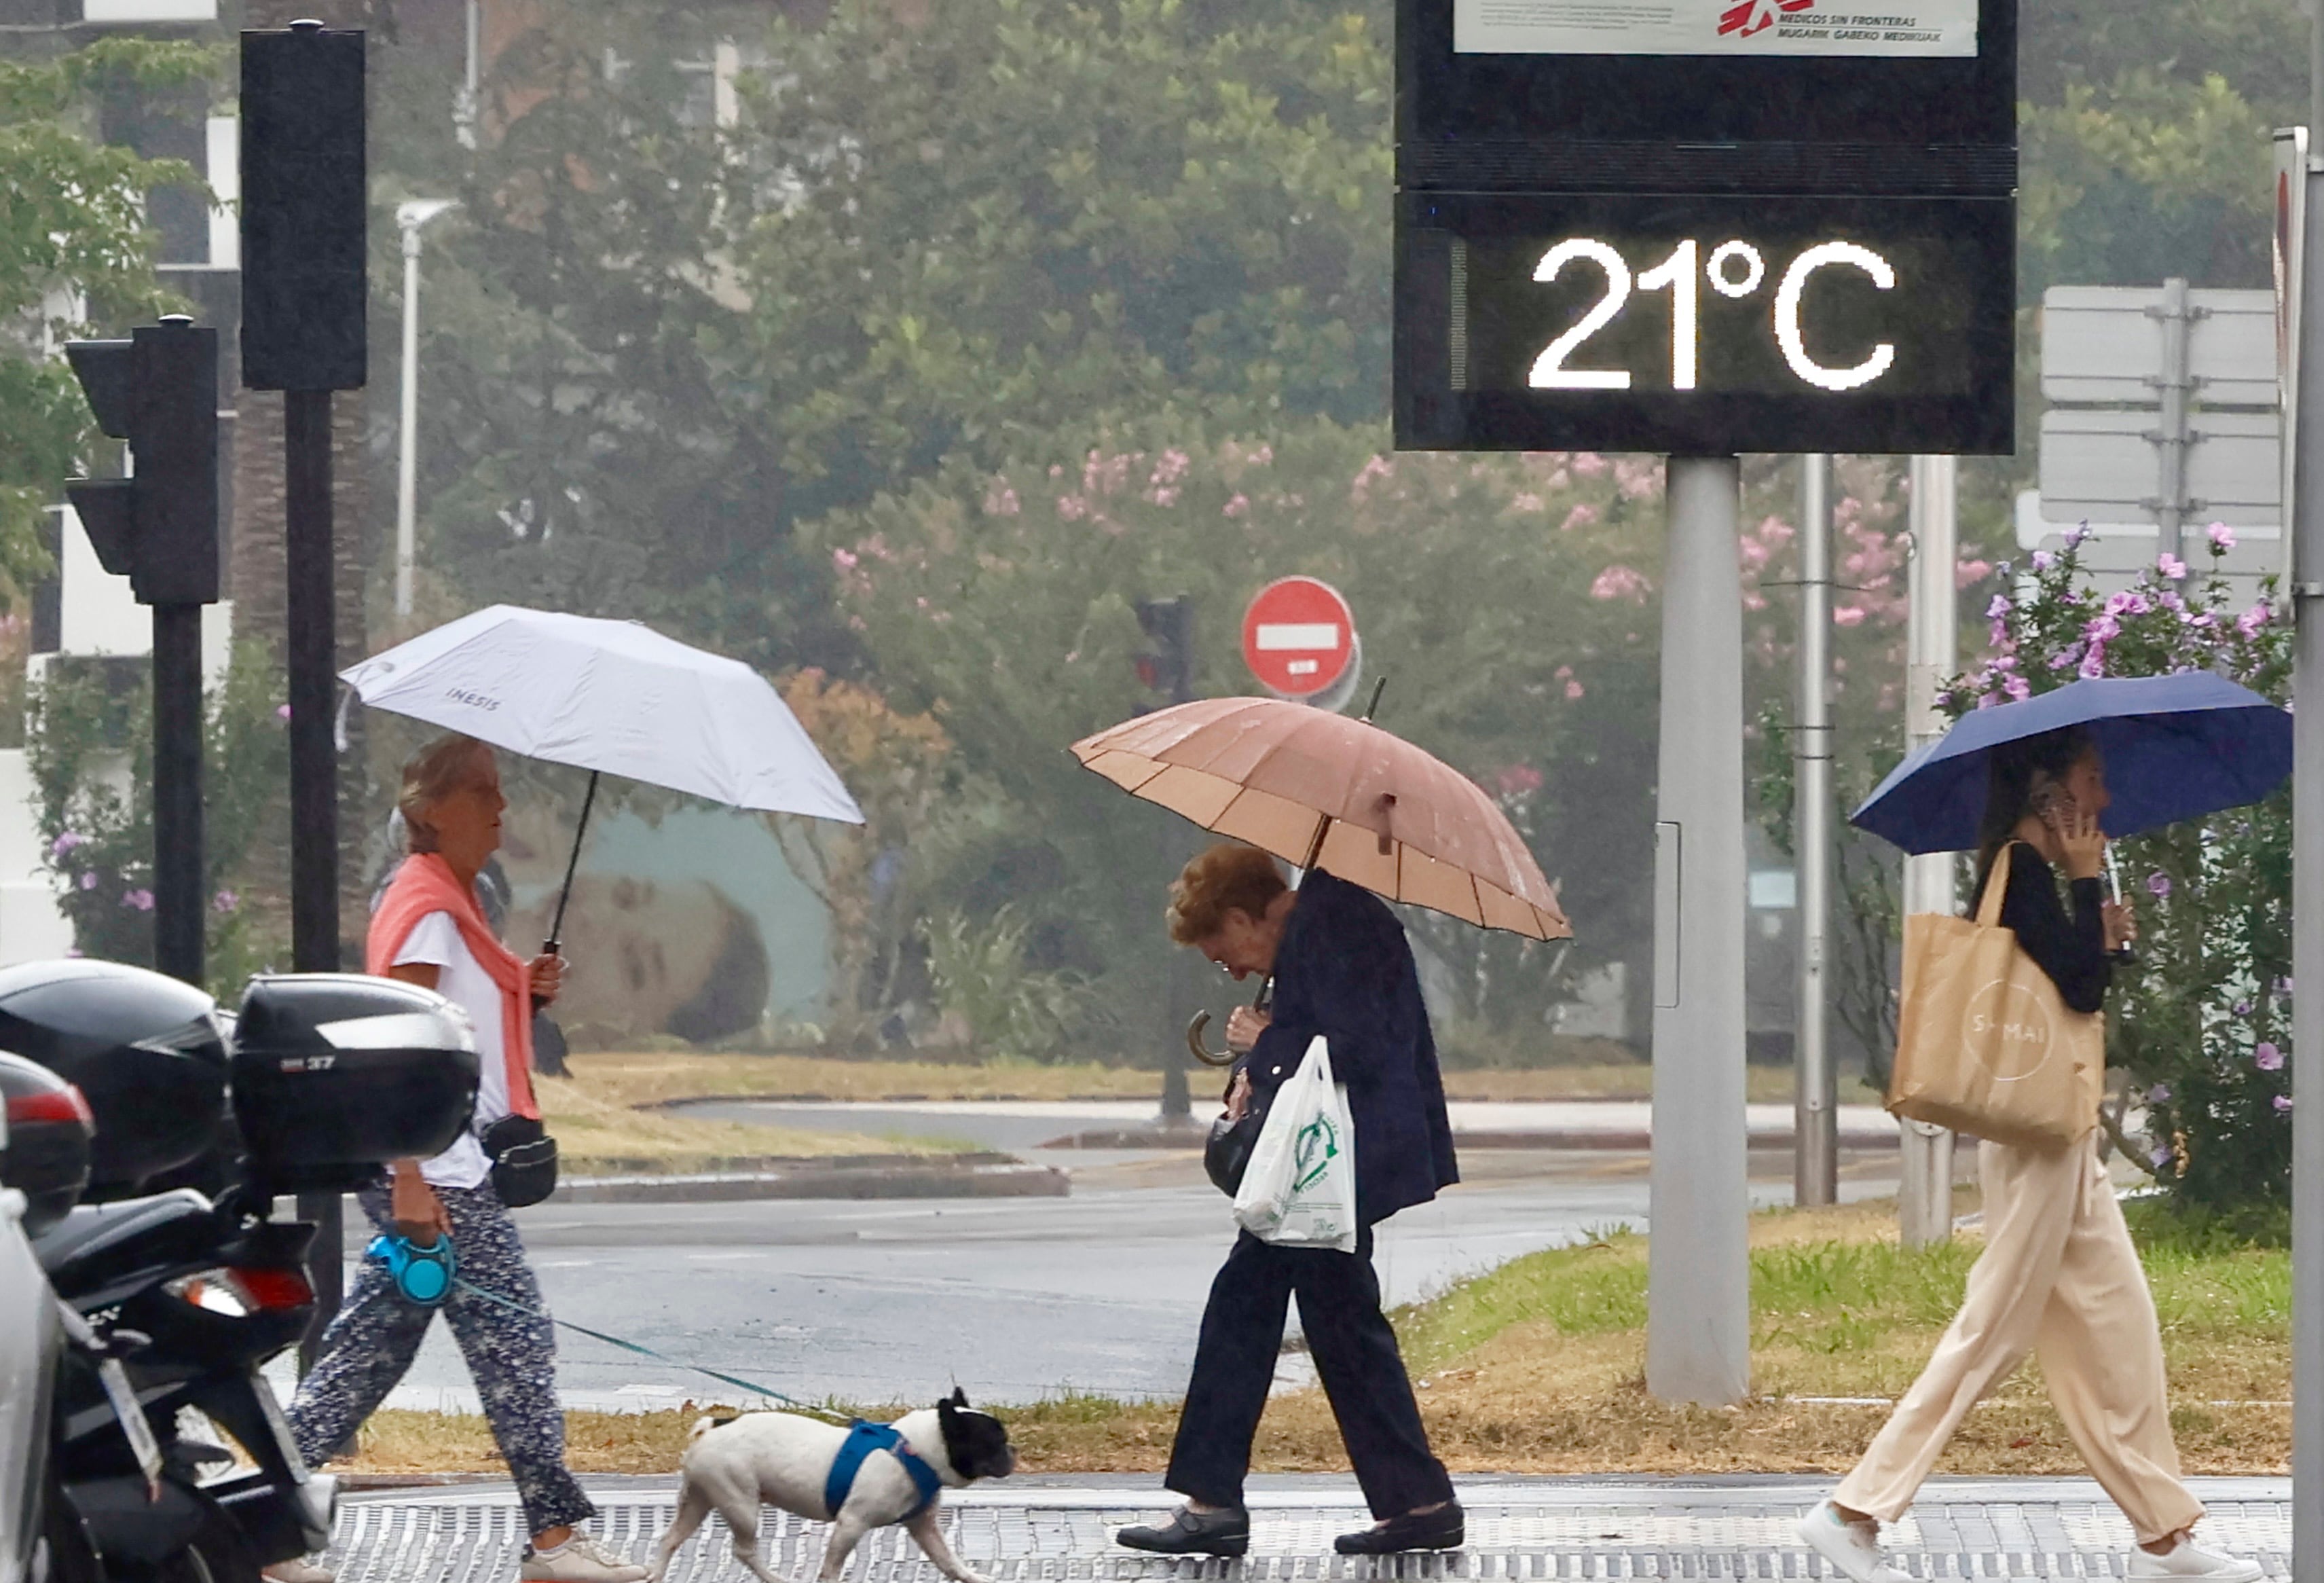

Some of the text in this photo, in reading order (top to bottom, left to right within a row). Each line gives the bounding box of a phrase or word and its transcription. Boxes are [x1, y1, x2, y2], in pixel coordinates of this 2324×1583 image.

[1829, 15, 1848, 25] SIN
[1850, 16, 1917, 27] FRONTERAS
[1777, 28, 1942, 43] MUGARIK GABEKO MEDIKUAK
[1528, 238, 1896, 390] 21°C
[445, 687, 501, 711] INESIS
